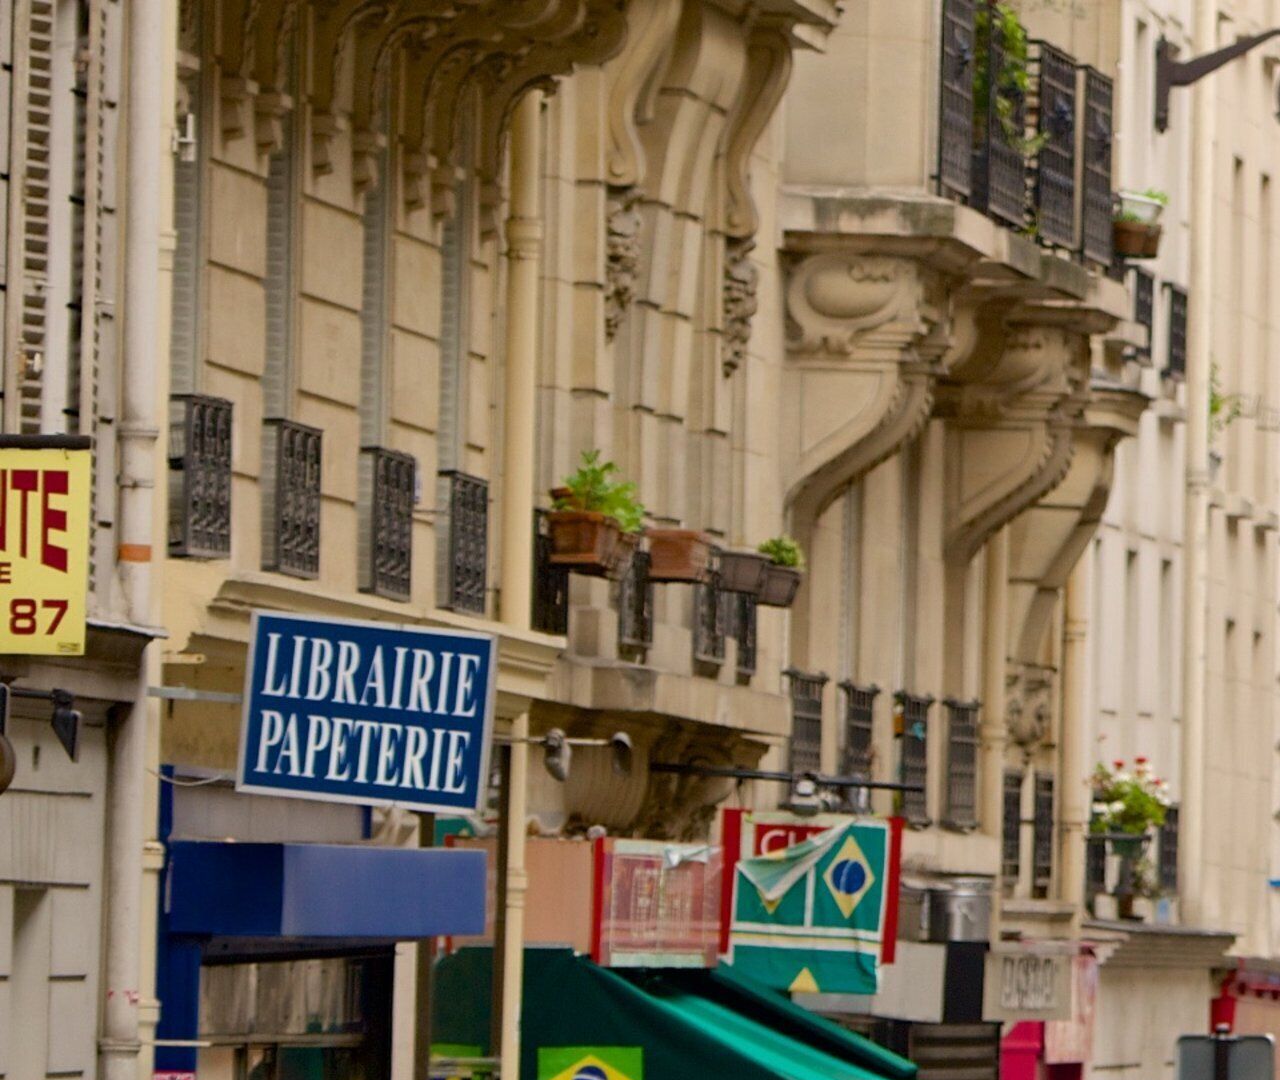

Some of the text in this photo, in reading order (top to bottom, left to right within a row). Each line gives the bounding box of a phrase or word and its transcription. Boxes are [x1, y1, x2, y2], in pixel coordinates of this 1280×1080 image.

[0, 469, 69, 574] TE
[9, 599, 69, 635] 87
[260, 632, 481, 718] LIBRAIRIE
[253, 709, 471, 795] PAPETERIE
